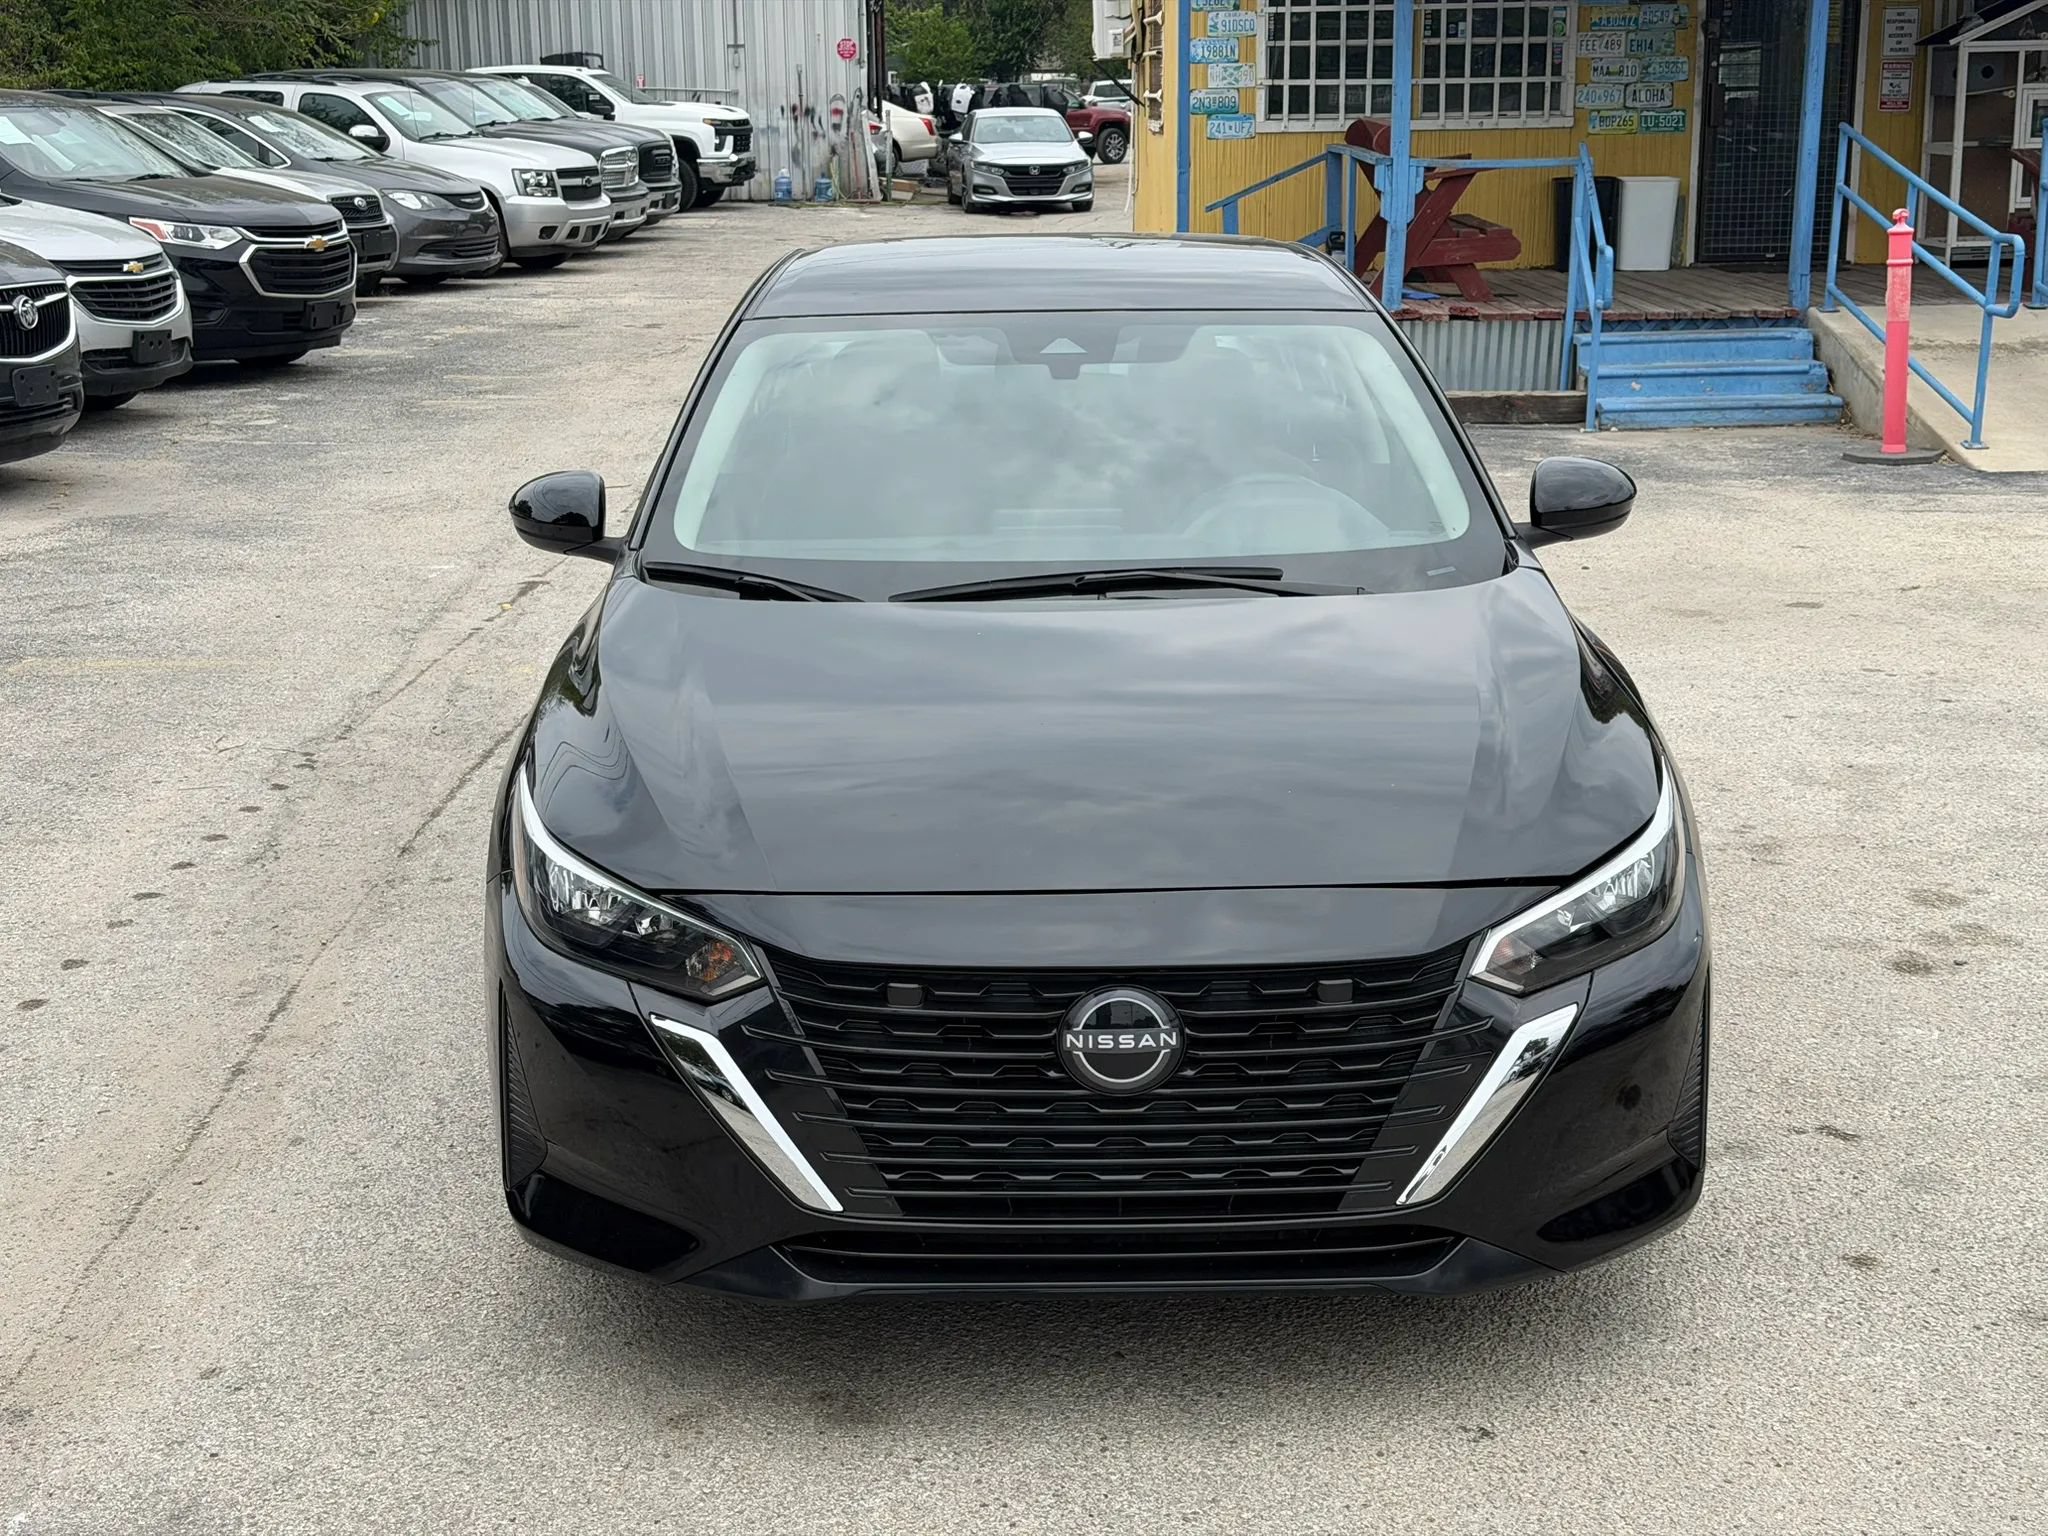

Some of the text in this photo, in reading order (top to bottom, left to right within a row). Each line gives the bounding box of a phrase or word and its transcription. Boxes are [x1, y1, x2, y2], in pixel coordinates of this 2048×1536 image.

[1579, 38, 1622, 51] FEE 489
[1192, 95, 1236, 110] 2N3 809
[1603, 89, 1622, 102] 967
[1631, 88, 1666, 103] ALOHA
[1210, 121, 1253, 134] 241 UFZ
[1066, 1031, 1177, 1049] NISSAN
